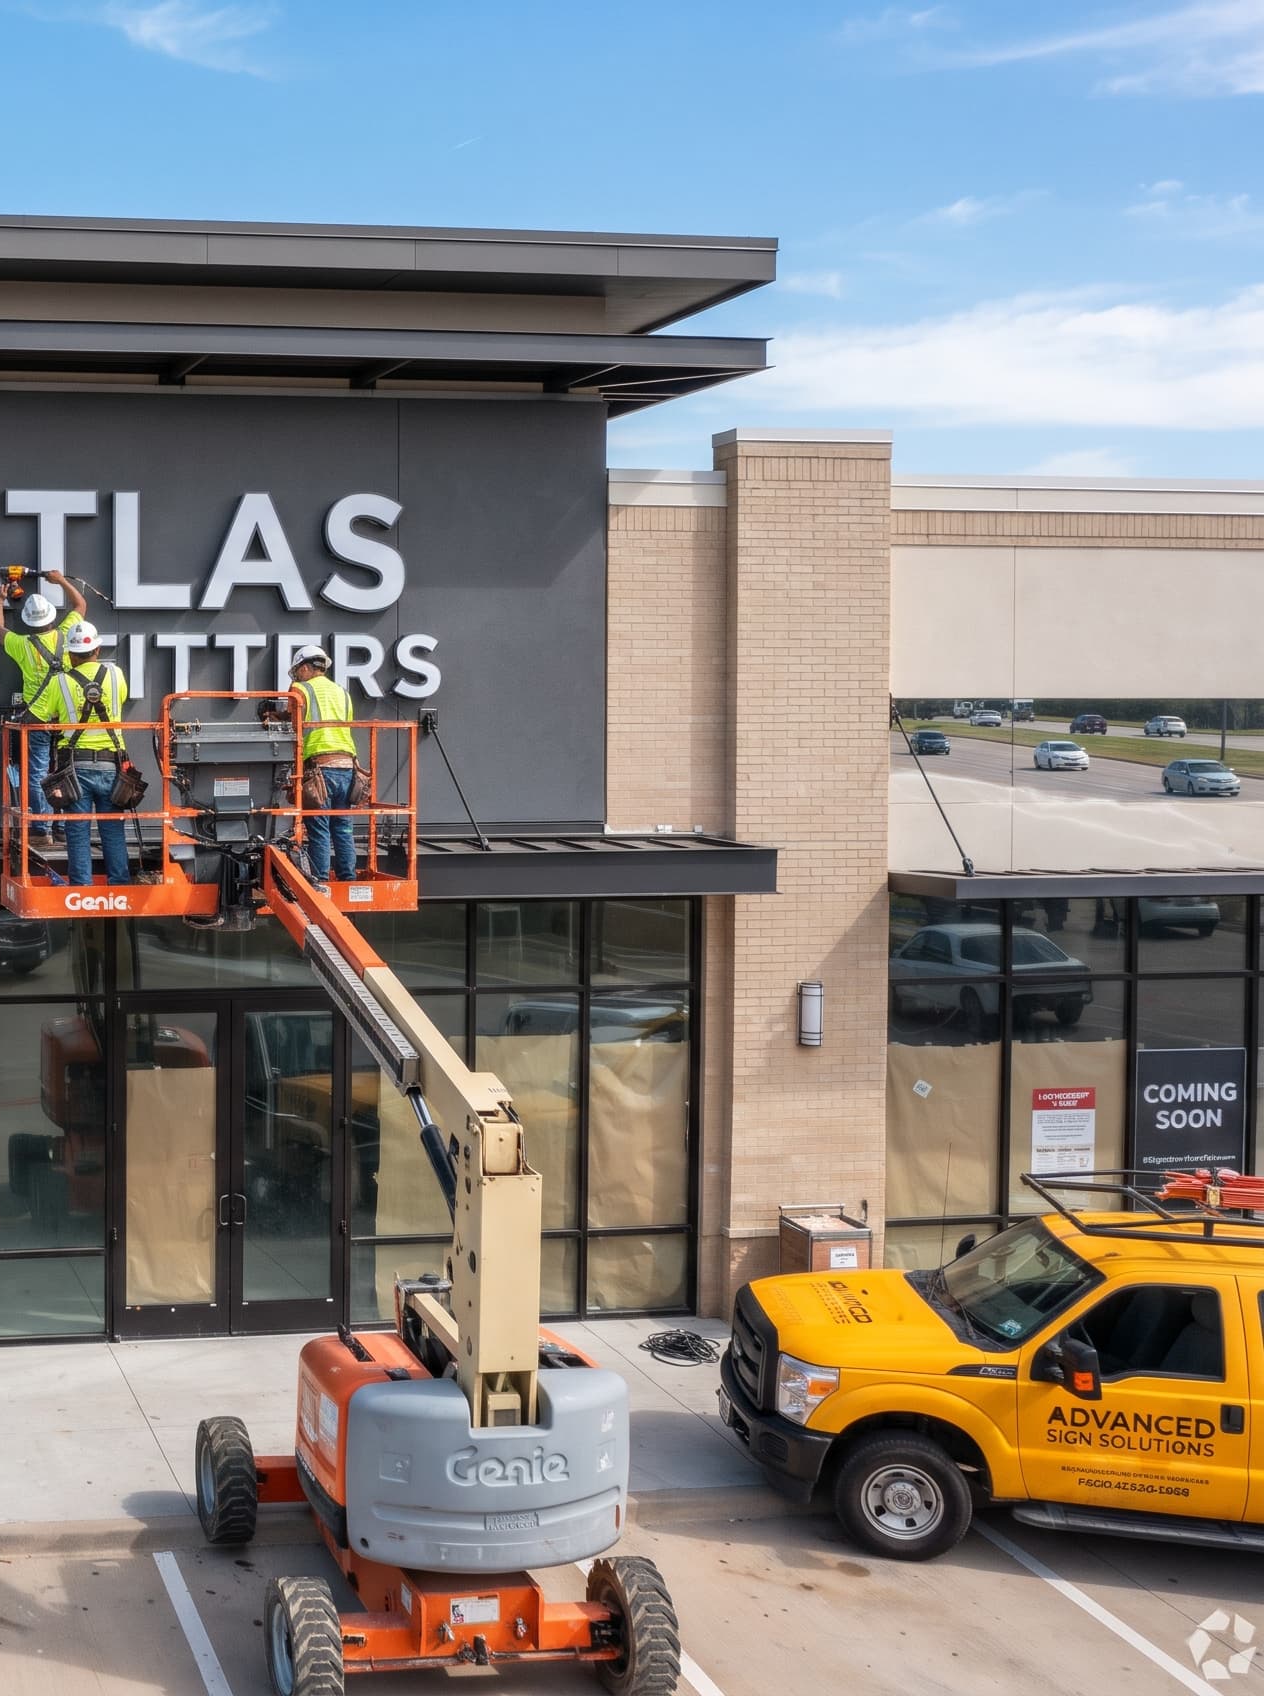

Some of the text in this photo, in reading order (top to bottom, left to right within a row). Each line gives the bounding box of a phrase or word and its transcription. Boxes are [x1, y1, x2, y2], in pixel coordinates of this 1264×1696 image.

[64, 892, 128, 911] Genie
[1143, 1082, 1238, 1103] COMING
[1155, 1108, 1223, 1129] SOON
[1047, 1406, 1216, 1439] ADVANCED
[1046, 1428, 1215, 1457] SIGN SOLUTIONS
[446, 1445, 570, 1487] Genie
